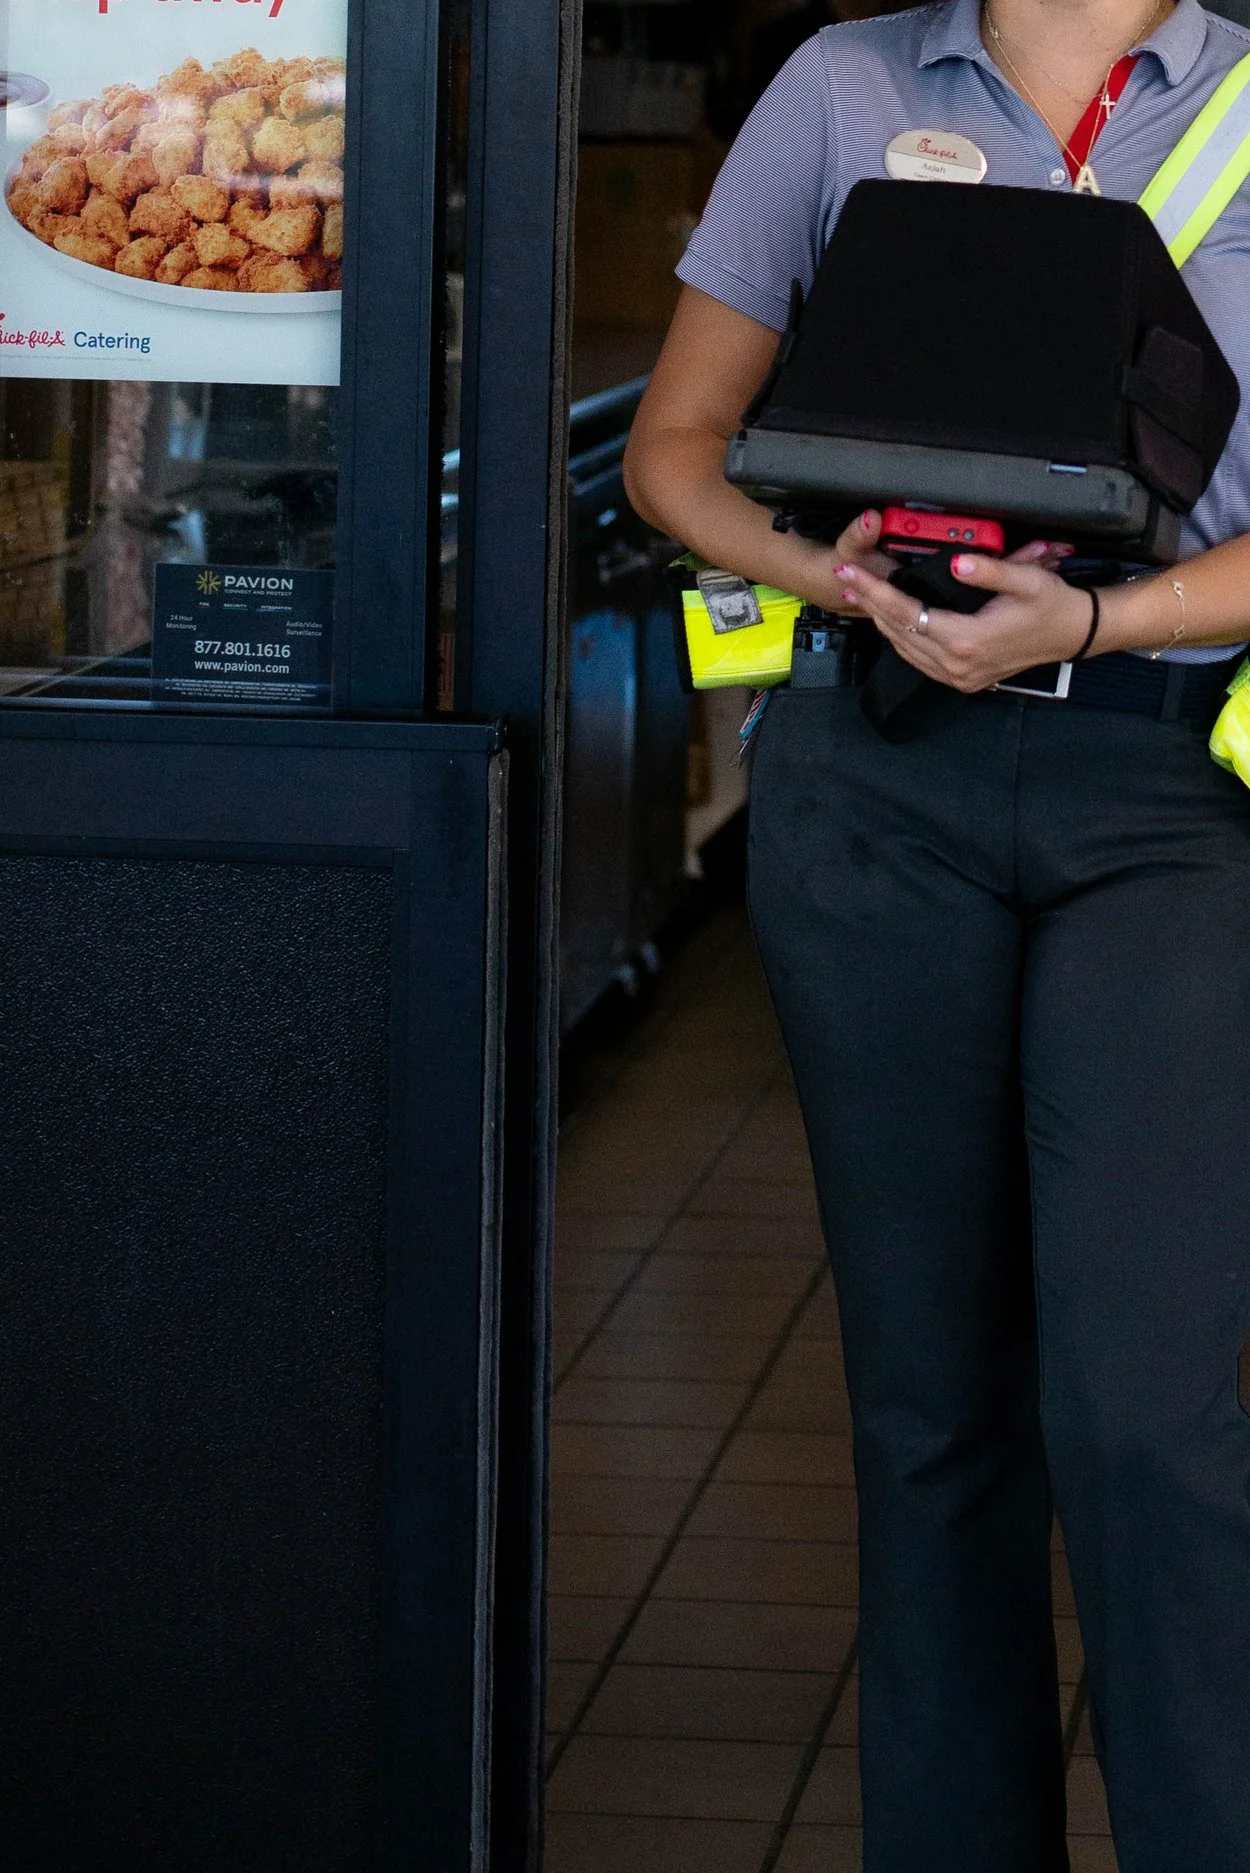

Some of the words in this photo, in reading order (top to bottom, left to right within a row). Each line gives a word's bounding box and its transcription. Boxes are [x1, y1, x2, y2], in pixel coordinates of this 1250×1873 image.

[1072, 164, 1102, 196] A
[0, 329, 66, 349] hick-fil-A
[74, 331, 151, 353] Catering
[224, 575, 294, 590] PAVION
[166, 622, 197, 631] Monitoring
[286, 621, 323, 629] Audio/Video
[286, 629, 322, 637] Surveillance
[194, 640, 291, 658] 877.801.1616
[194, 660, 290, 674] www.pavion.com
